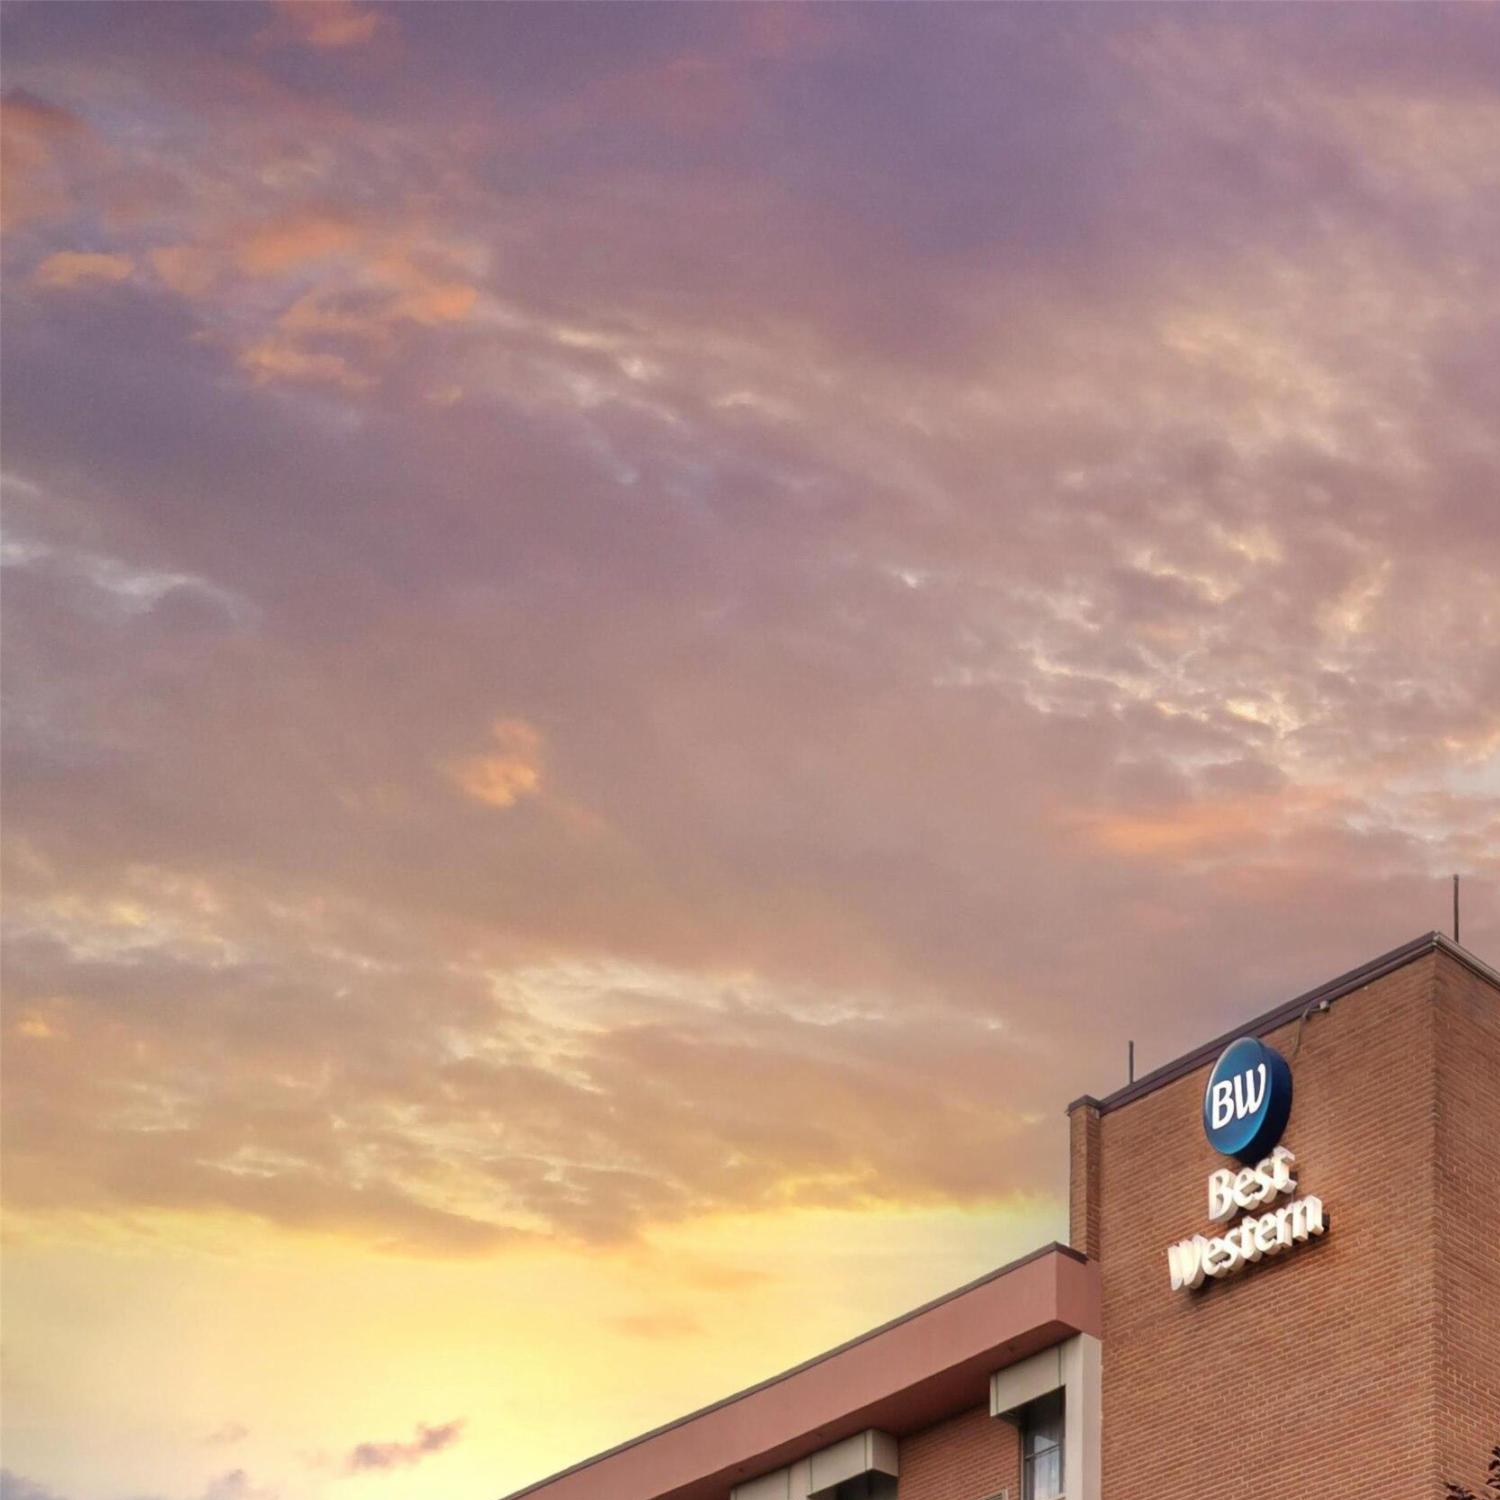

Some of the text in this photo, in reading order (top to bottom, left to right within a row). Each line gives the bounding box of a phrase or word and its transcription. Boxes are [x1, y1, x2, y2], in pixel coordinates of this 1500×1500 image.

[1212, 1063, 1266, 1130] BW
[1208, 1145, 1298, 1224] Best
[1167, 1194, 1326, 1291] Western
